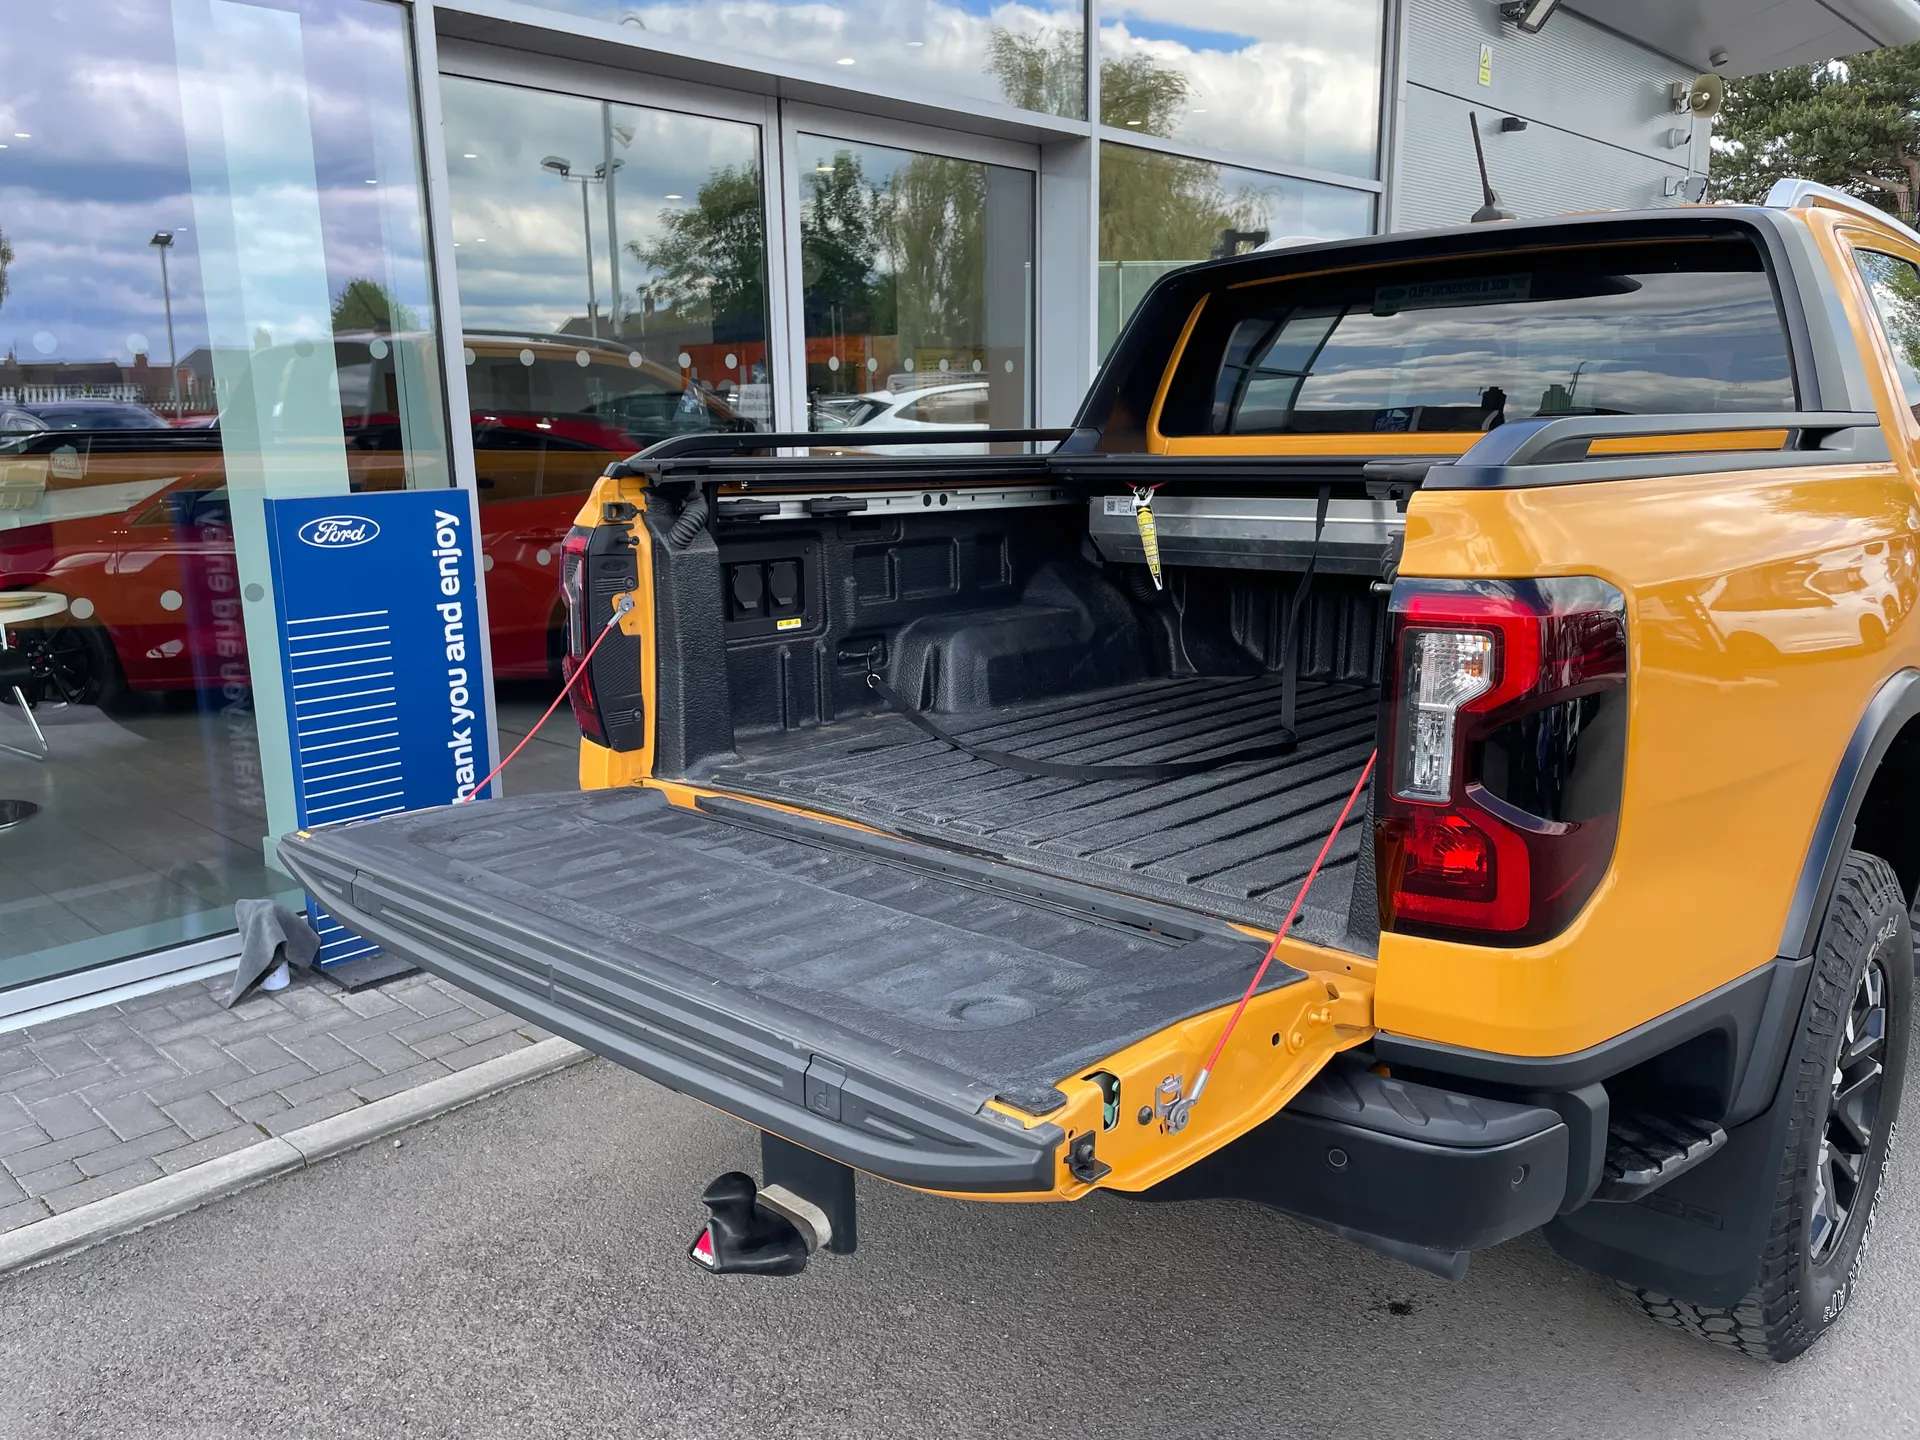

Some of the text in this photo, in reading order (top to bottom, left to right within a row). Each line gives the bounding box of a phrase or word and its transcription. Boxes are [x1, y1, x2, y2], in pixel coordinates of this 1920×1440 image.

[314, 520, 366, 543] Ford
[432, 510, 476, 804] hank you and enjoy
